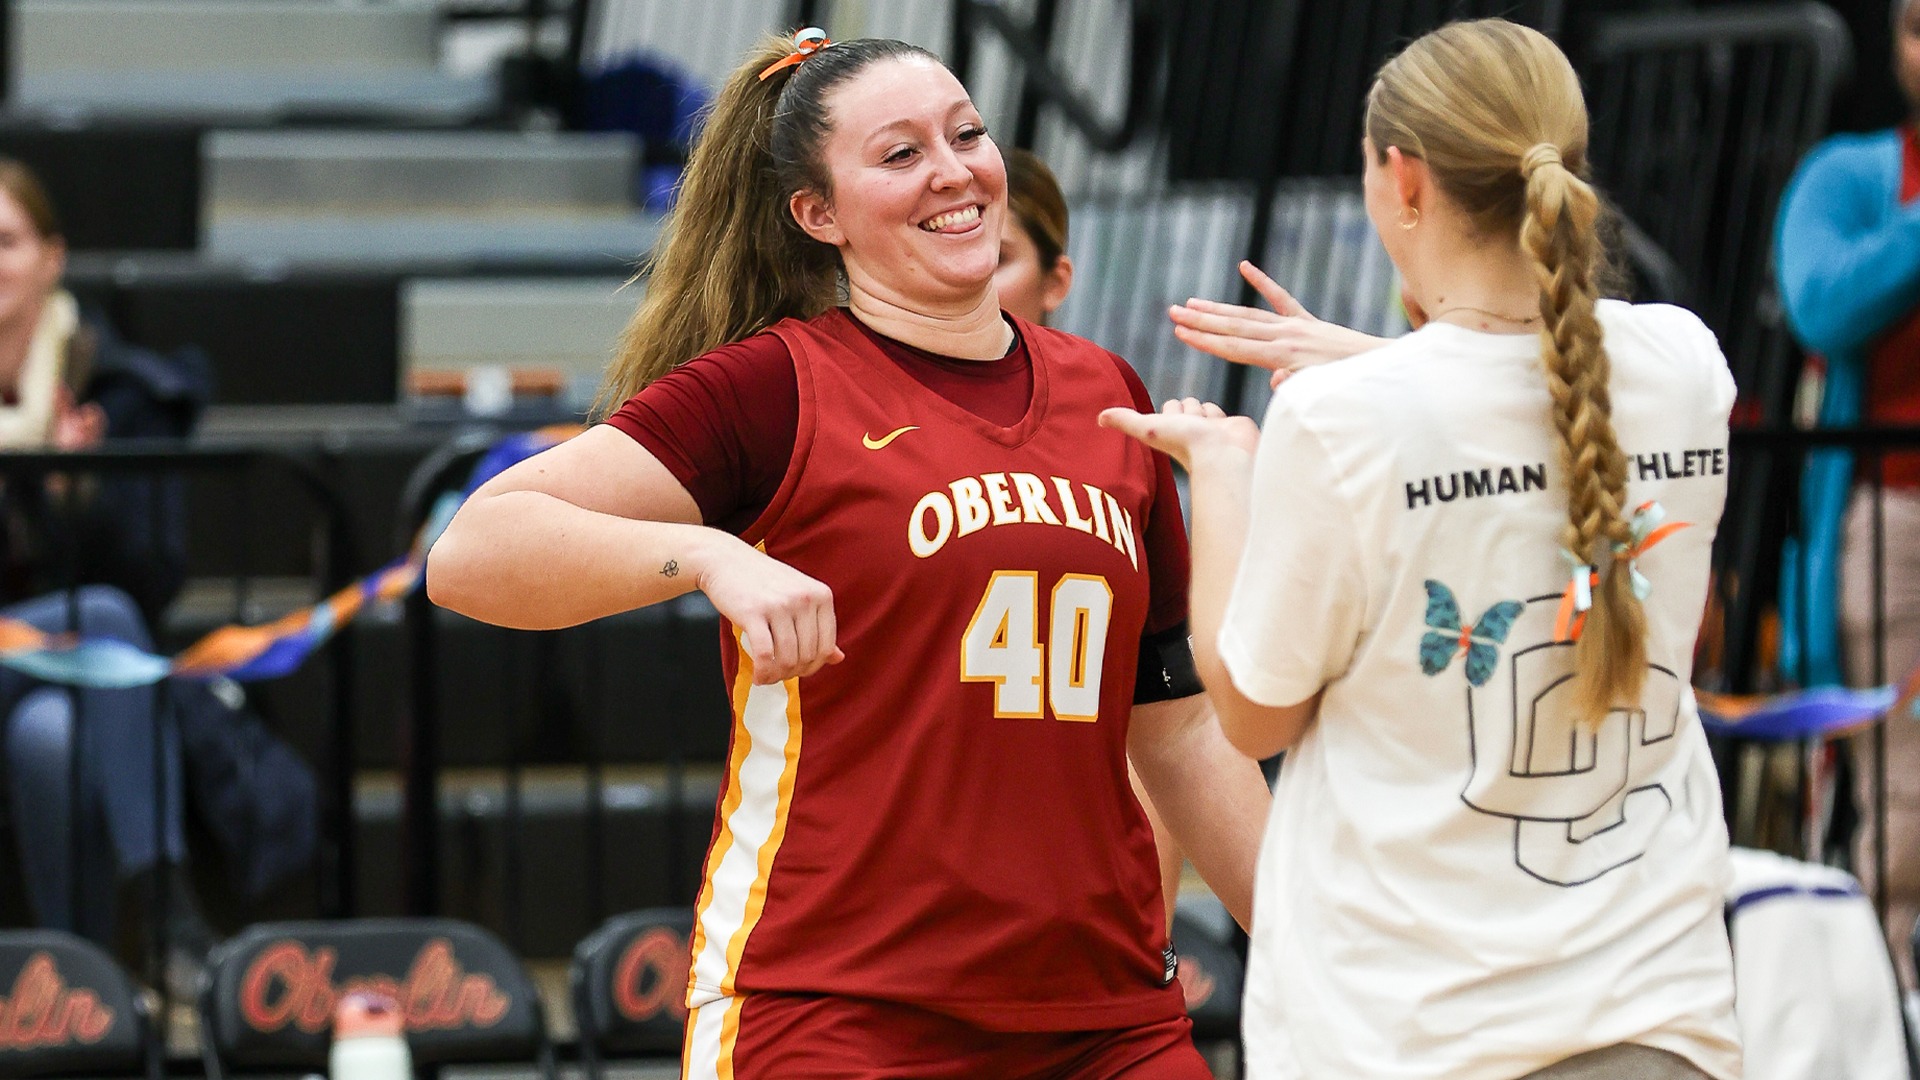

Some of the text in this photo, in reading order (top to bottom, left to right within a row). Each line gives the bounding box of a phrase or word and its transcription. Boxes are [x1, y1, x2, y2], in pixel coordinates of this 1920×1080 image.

[908, 472, 1139, 572] OBERLIN
[1406, 448, 1724, 509] HUMAN HLETE
[960, 570, 1114, 722] 40
